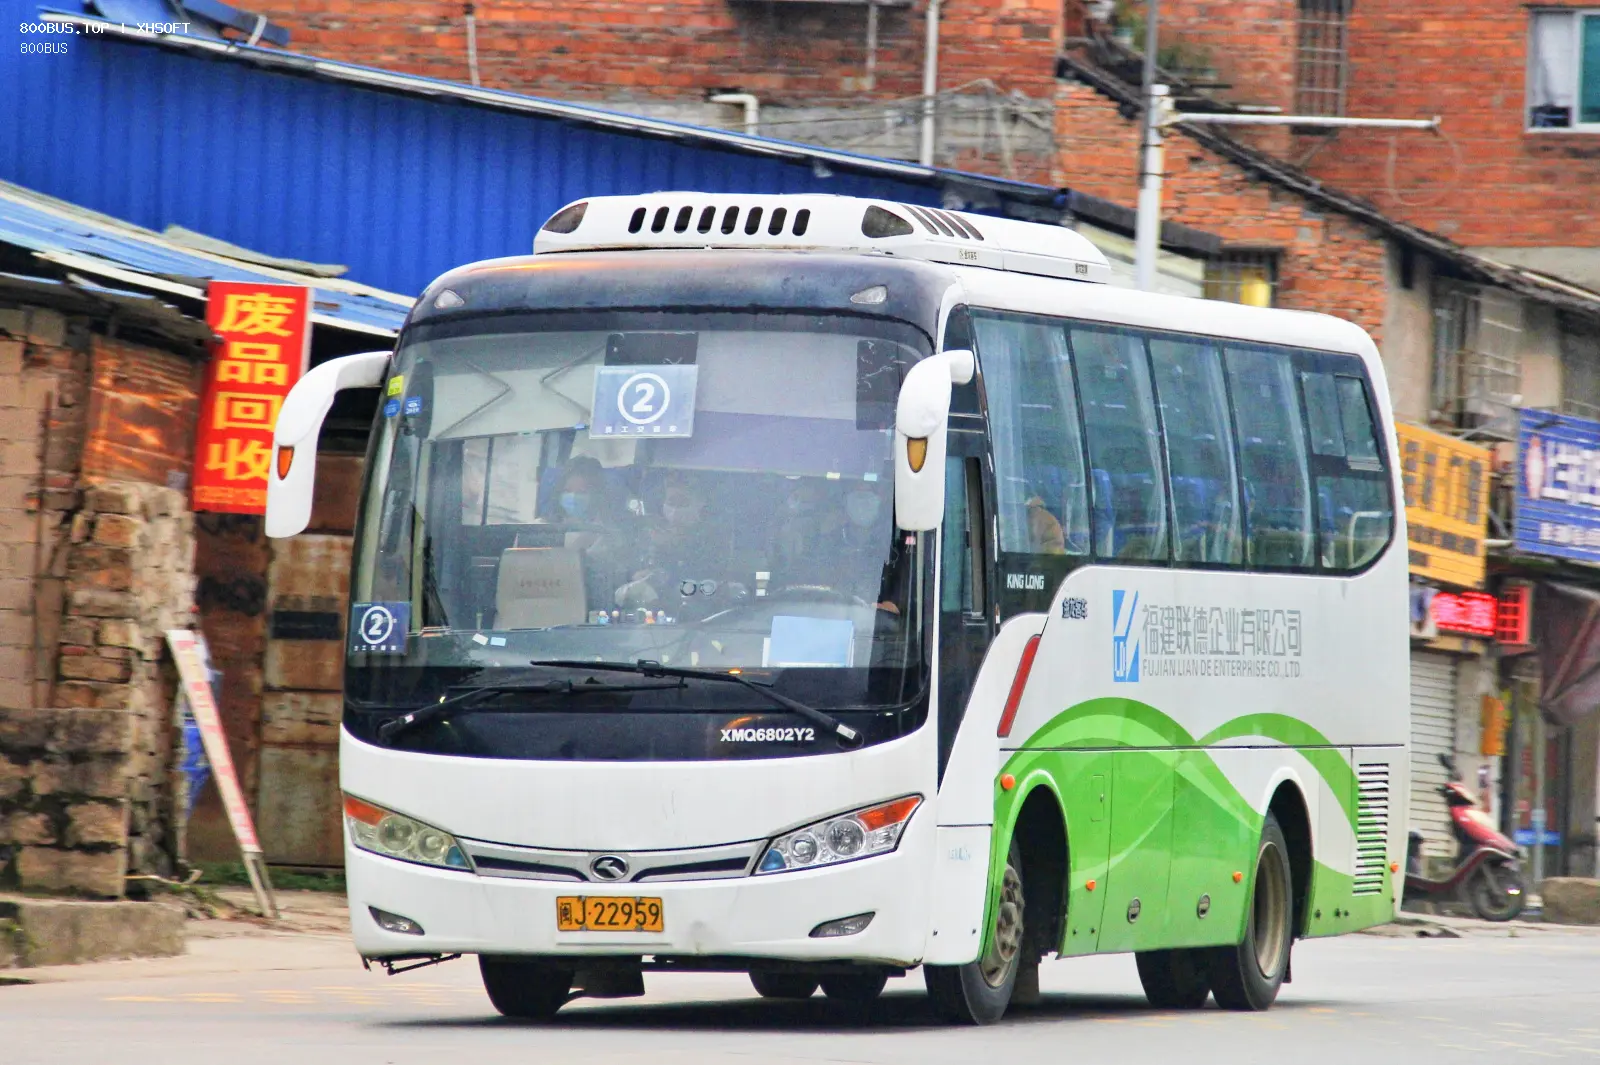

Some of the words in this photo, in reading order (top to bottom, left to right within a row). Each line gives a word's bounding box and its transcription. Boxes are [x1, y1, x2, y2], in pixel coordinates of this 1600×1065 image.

[205, 292, 296, 482] 废品回收
[1006, 573, 1024, 589] KING
[1025, 574, 1045, 590] LONG
[1142, 604, 1302, 657] 福建联德企业有限公司
[1142, 658, 1175, 677] FUJIAN
[1177, 659, 1200, 677] LIAN
[1200, 659, 1212, 677] DE
[1213, 659, 1266, 677] ENTERPRISE
[720, 728, 815, 742] XMQ6802Y2
